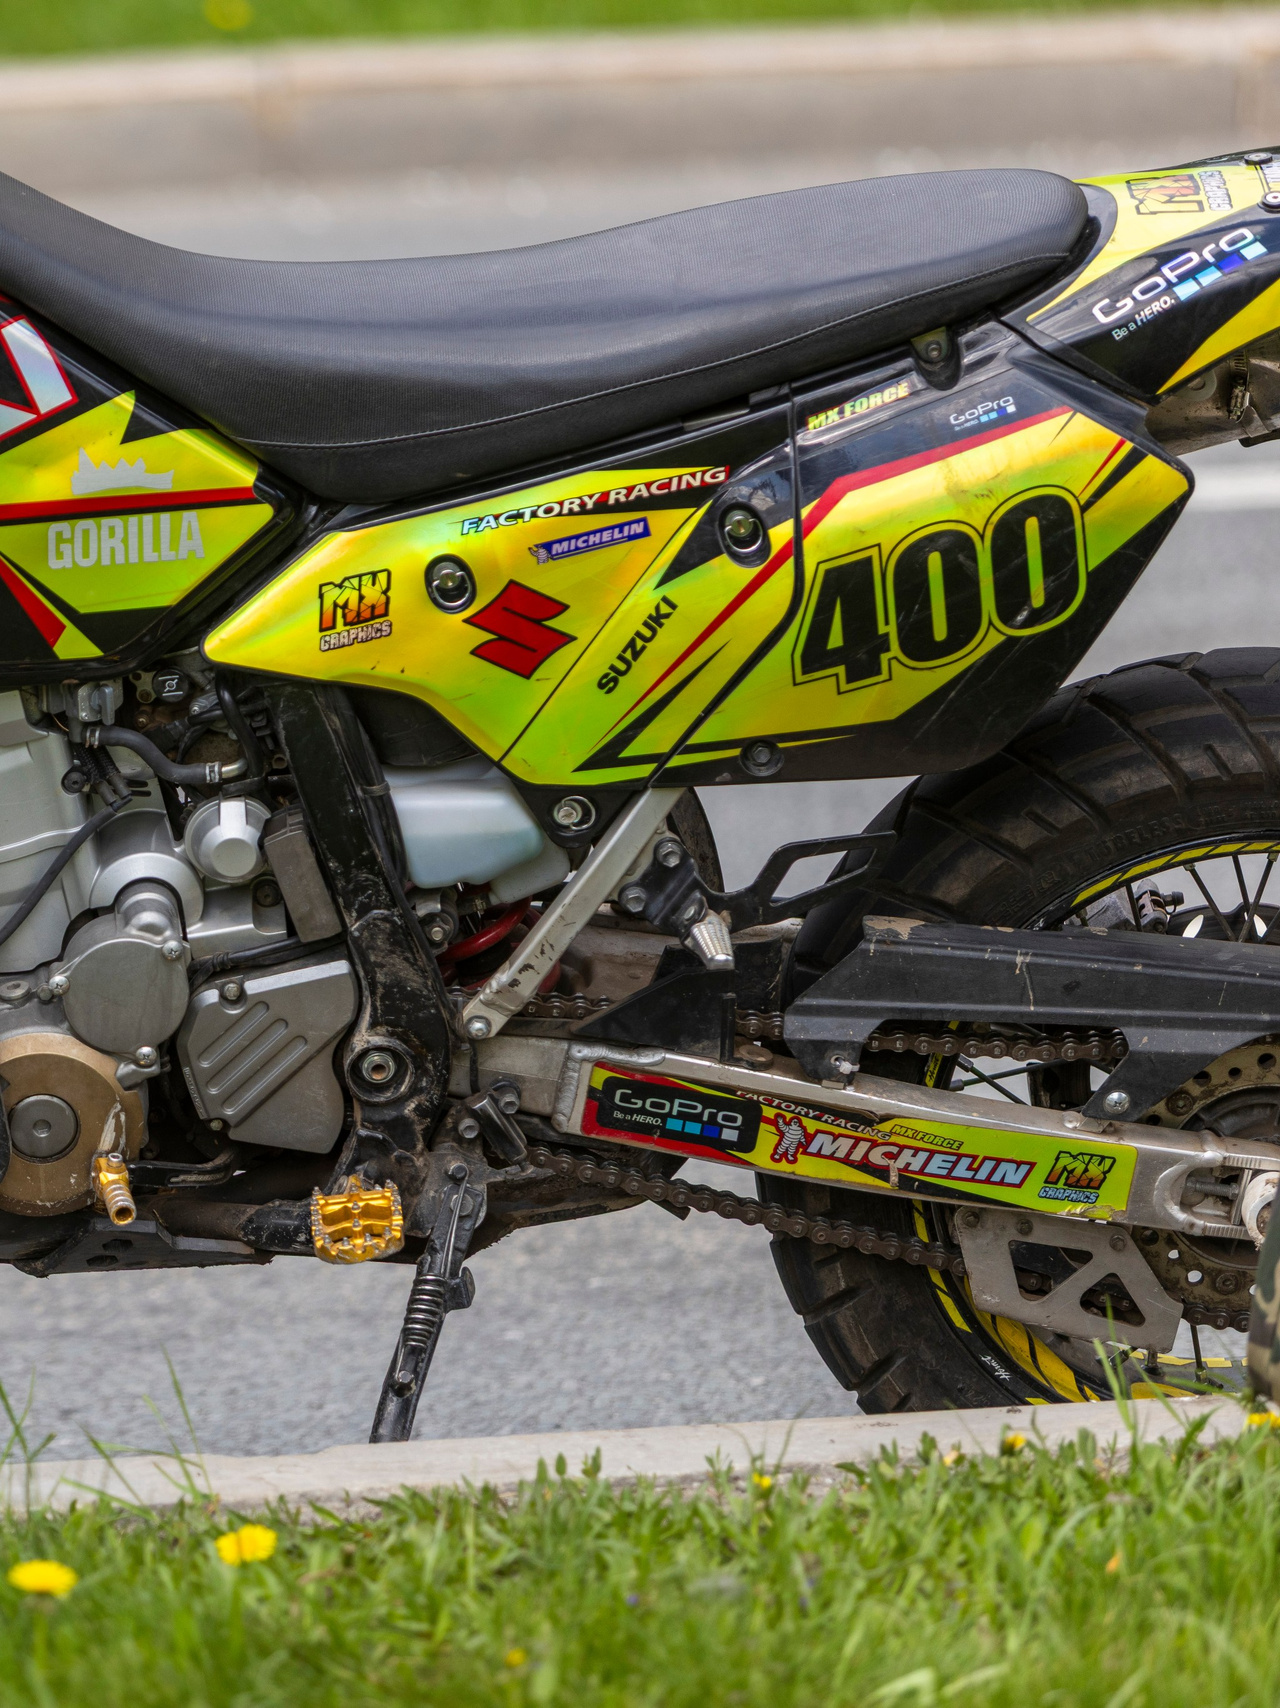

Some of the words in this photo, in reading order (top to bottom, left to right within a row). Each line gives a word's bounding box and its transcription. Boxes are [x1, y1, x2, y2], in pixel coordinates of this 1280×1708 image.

[1125, 173, 1206, 216] MX
[1092, 228, 1256, 324] GoPro
[1112, 328, 1130, 341] Be
[1128, 321, 1138, 331] a
[1135, 294, 1176, 326] HERO.
[807, 405, 841, 432] MX
[844, 381, 911, 418] FORCE
[949, 396, 1014, 426] GoPro
[461, 491, 600, 536] FACTORY
[607, 466, 728, 505] RACING
[47, 511, 206, 570] GORILLA
[551, 521, 646, 556] MICHELIN
[318, 568, 392, 633] MX
[791, 484, 1089, 695] 400
[319, 619, 393, 653] GRAPHICS
[596, 594, 679, 695] SUZUKI
[613, 1110, 625, 1121] Be
[625, 1113, 631, 1121] a
[632, 1113, 663, 1127] HERO.
[614, 1089, 744, 1128] GoPro
[736, 1090, 821, 1120] FACTORY
[820, 1113, 891, 1142] RACING
[807, 1132, 1034, 1187] MICHELIN
[890, 1123, 918, 1141] MX
[915, 1130, 965, 1151] FORCE
[1043, 1151, 1117, 1192] MX
[1036, 1186, 1100, 1205] GRAPHICS
